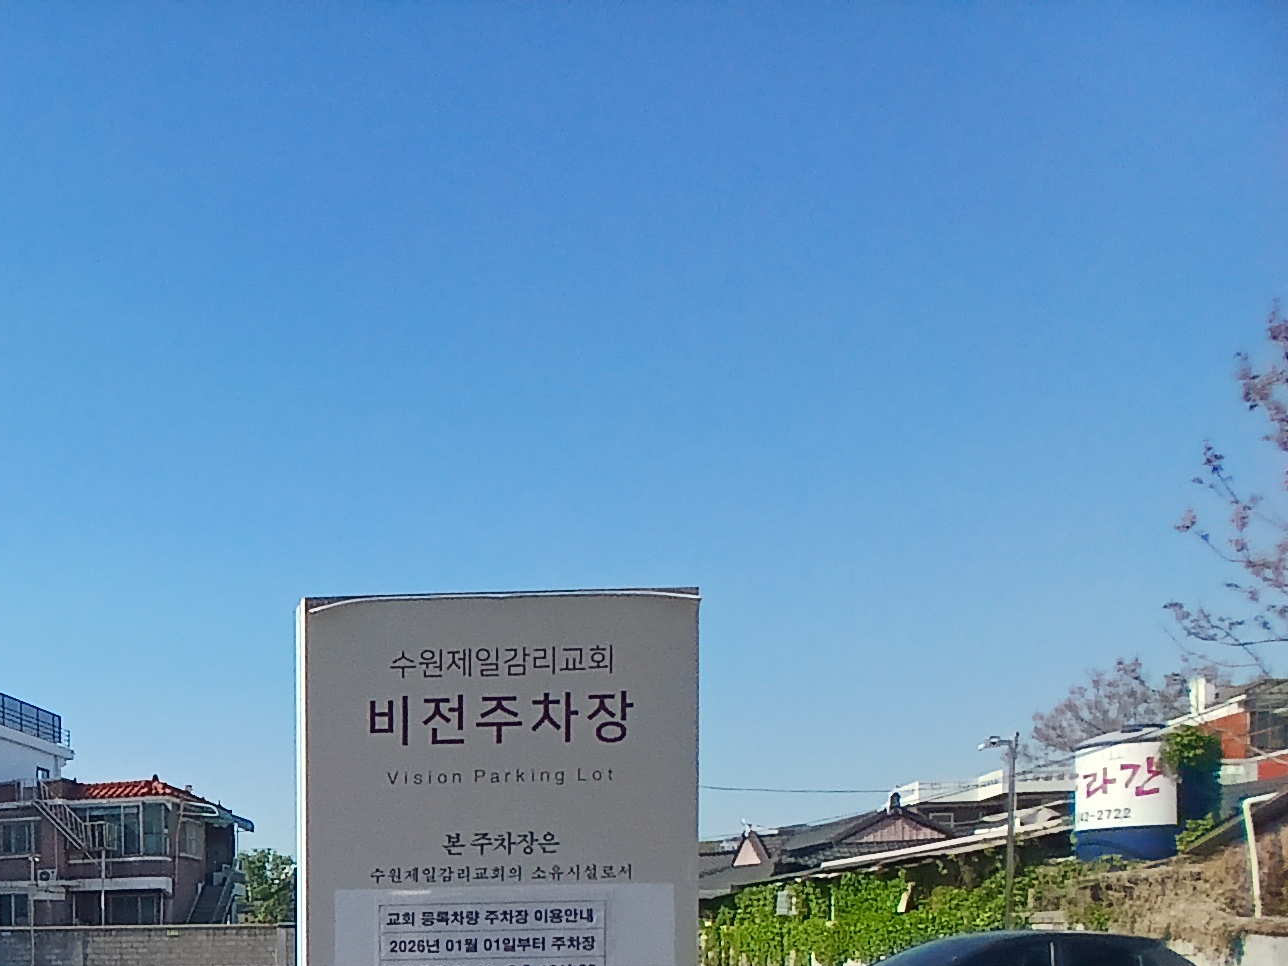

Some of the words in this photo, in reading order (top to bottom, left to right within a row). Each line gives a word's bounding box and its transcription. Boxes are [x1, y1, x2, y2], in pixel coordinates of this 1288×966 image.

[390, 645, 613, 678] 수원제일감리교회
[370, 691, 634, 746] 비전주차장
[387, 771, 461, 784] Vision
[475, 769, 564, 785] Parking
[578, 768, 613, 781] Lot
[442, 833, 466, 855] 본
[470, 831, 560, 855] 주차장은
[371, 865, 521, 884] 수원제일감리교회의
[532, 864, 631, 881] 소유시설로서
[386, 912, 415, 926] 교회
[422, 910, 480, 926] 등록차량
[485, 910, 528, 924] 주차장
[534, 908, 593, 923] 이용안내
[390, 939, 440, 953] 2026년
[446, 938, 477, 953] 01월
[484, 937, 545, 952] 01일부터
[551, 936, 595, 951] 주차장
